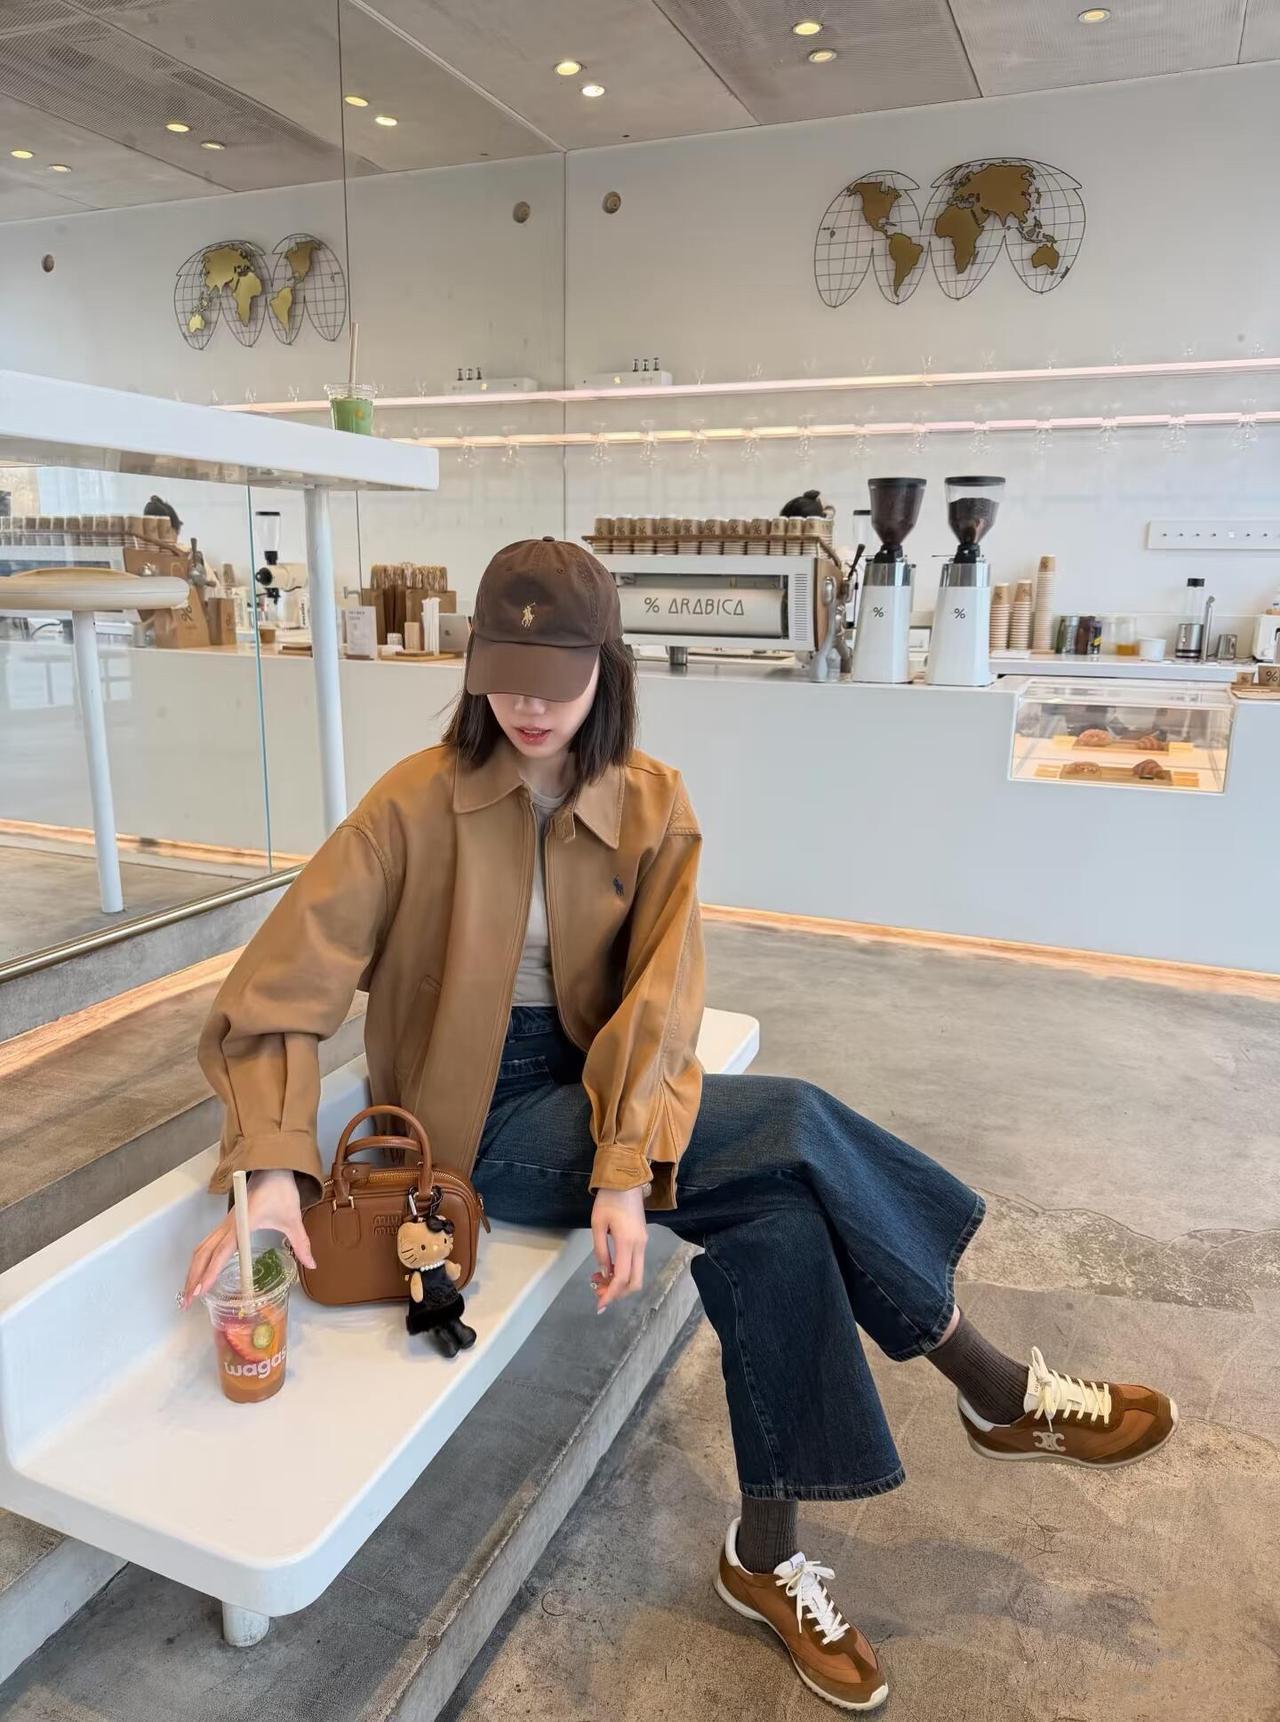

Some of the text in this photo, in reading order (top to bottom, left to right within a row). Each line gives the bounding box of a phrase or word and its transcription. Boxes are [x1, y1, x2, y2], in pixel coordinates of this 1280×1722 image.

[644, 597, 745, 616] % ARABICA
[873, 606, 884, 618] %
[954, 608, 966, 619] %
[1266, 670, 1278, 682] %
